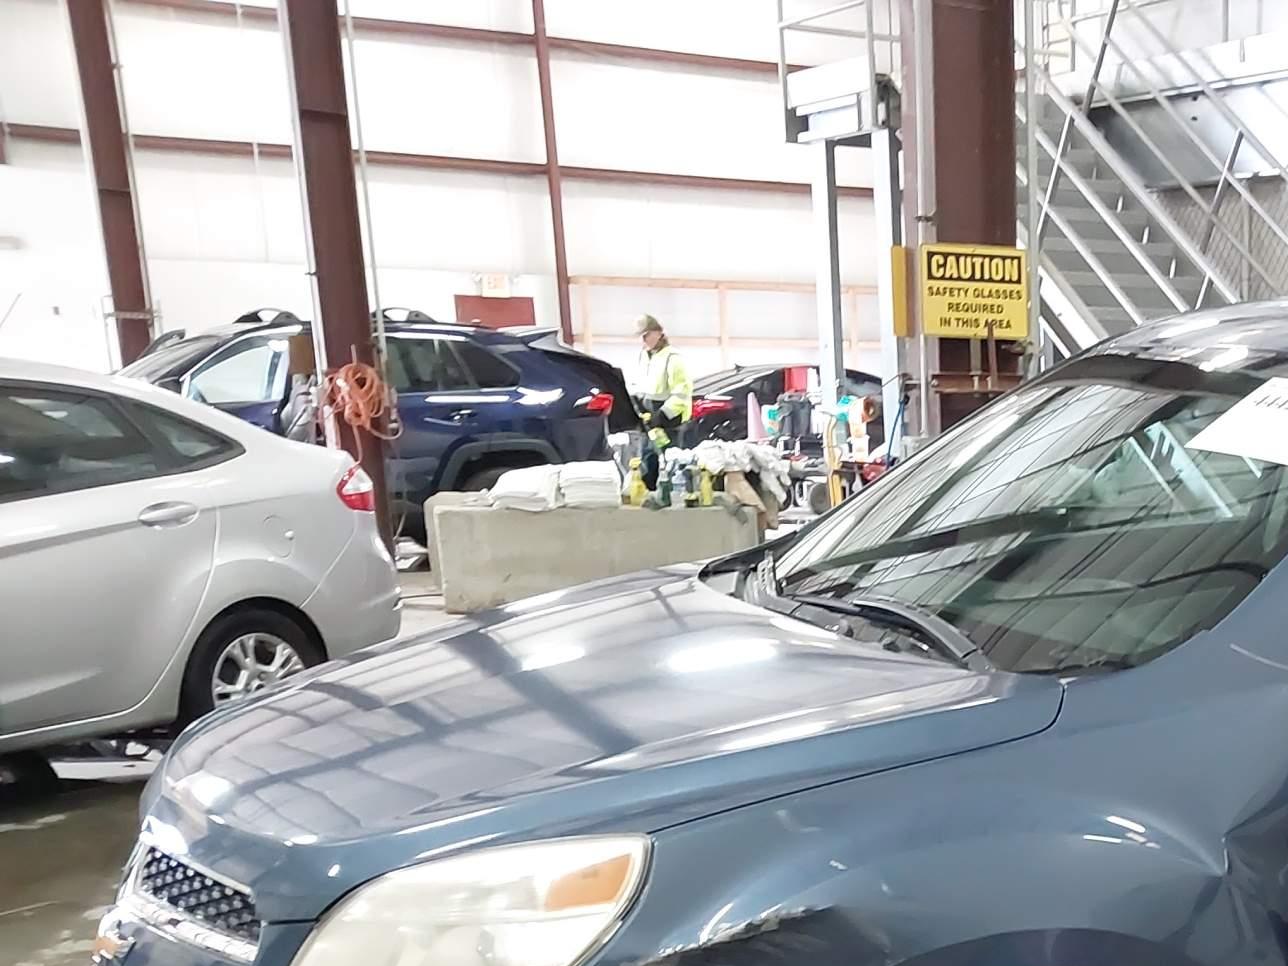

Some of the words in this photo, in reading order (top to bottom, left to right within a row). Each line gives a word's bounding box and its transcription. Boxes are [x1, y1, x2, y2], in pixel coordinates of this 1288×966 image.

[930, 254, 1019, 281] CAUTION
[927, 286, 969, 298] SAFETY
[973, 288, 1022, 300] GLASSES
[947, 302, 1004, 314] REQUIRED
[940, 317, 952, 328] IN
[955, 317, 980, 329] THIS
[983, 318, 1012, 329] AREA
